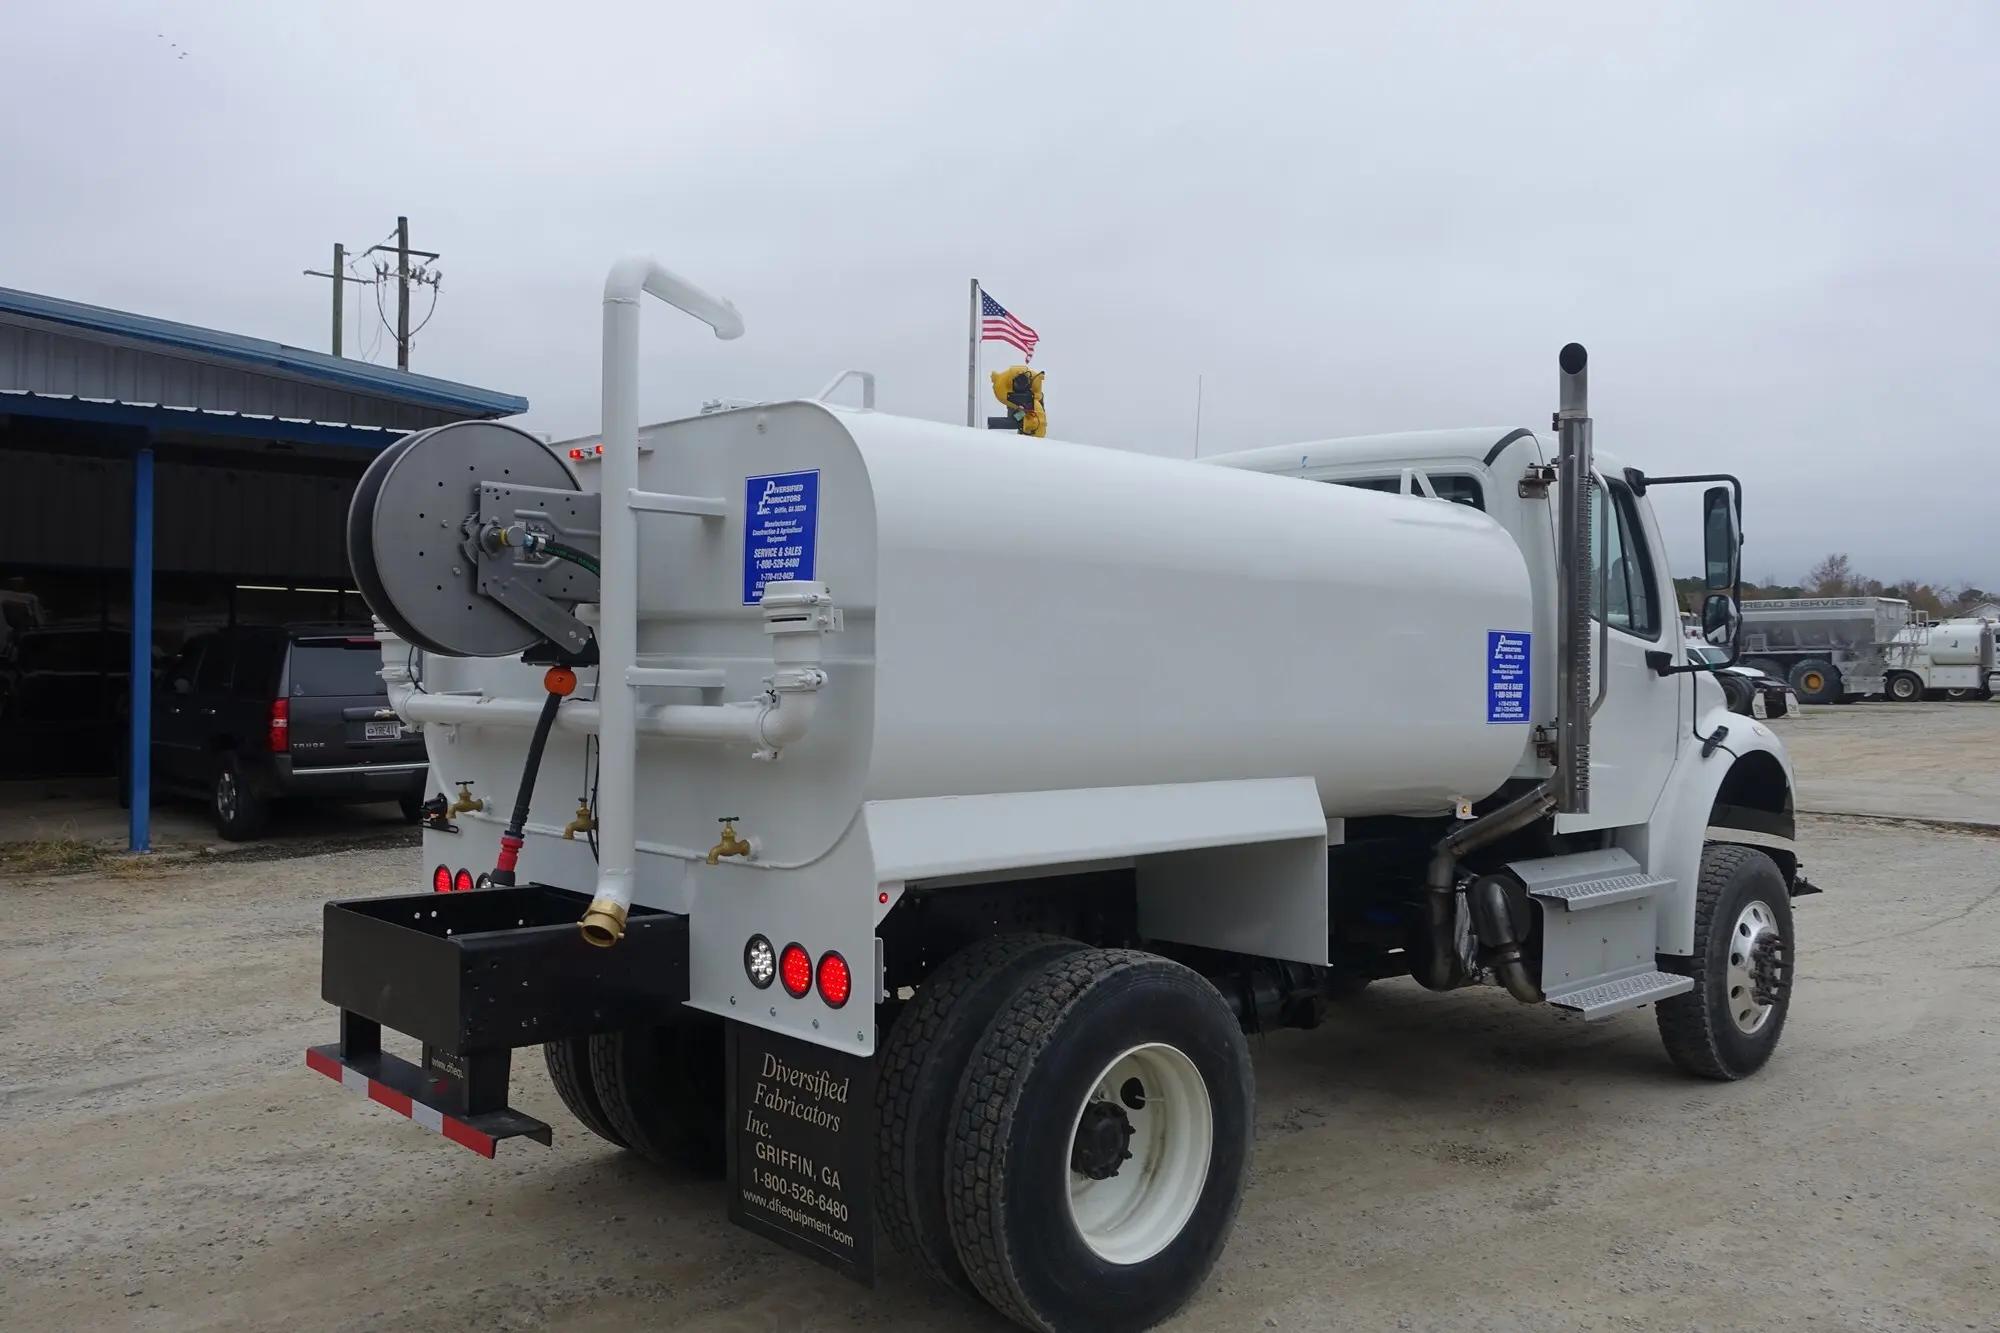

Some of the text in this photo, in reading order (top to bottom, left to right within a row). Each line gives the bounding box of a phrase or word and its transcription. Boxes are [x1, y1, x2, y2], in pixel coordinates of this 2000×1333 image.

[753, 546, 802, 558] SERVICE & SALES
[1790, 599, 1866, 609] SERVICES
[762, 1052, 849, 1104] Diversified
[745, 1109, 772, 1139] Inc.
[754, 1082, 841, 1133] Fabricators
[755, 1141, 841, 1191] GRIFFIN, GA
[743, 1189, 854, 1248] www.dfiequipment.com
[753, 1167, 848, 1222] 1-800-526-6480
